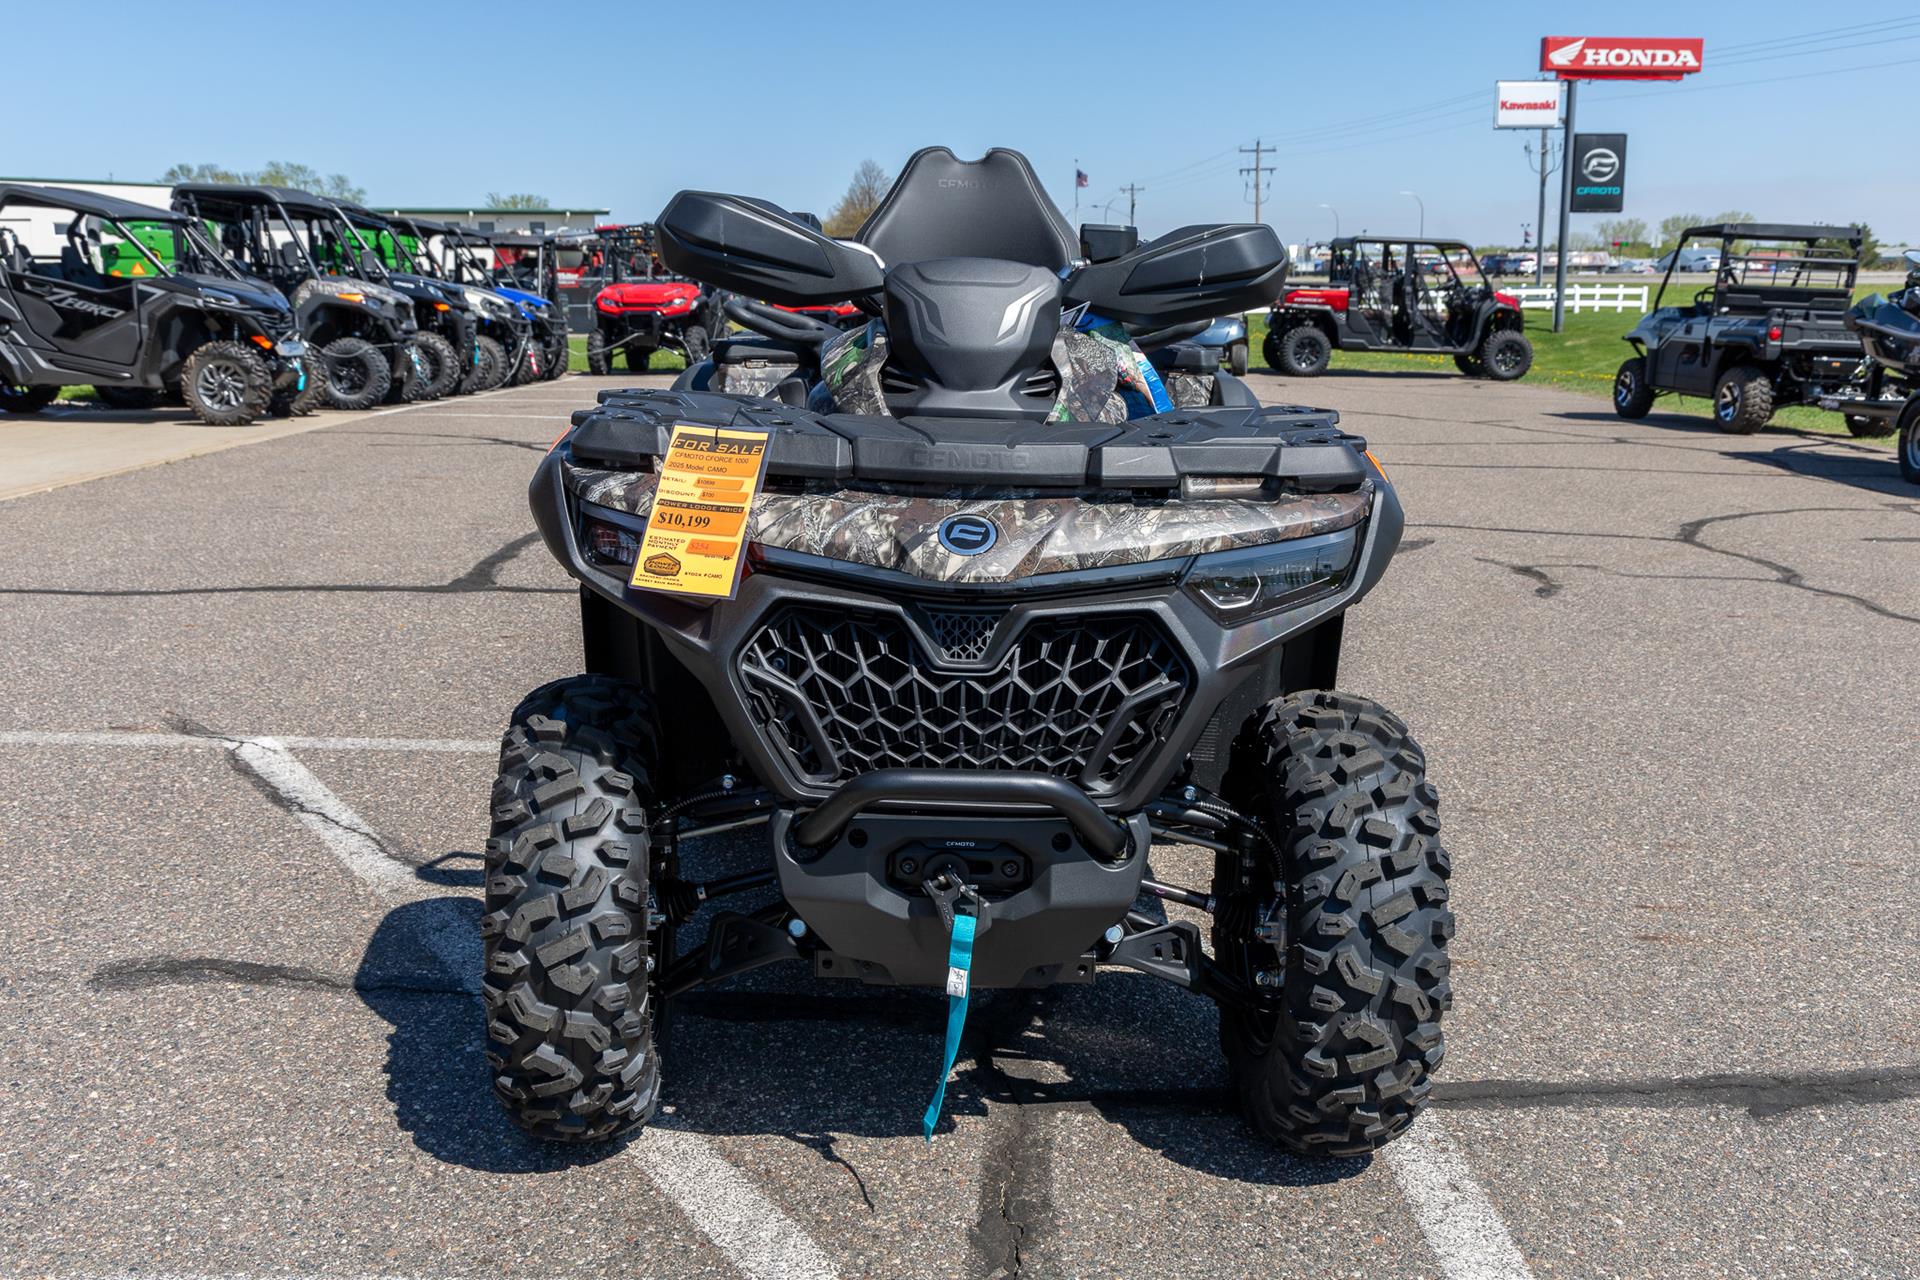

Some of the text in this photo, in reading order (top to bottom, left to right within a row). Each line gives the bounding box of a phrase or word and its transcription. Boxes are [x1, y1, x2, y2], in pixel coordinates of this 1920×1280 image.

[1583, 48, 1700, 67] HONDA
[1500, 100, 1557, 111] Kawasaki
[938, 178, 1002, 190] CFMO
[1576, 186, 1621, 195] CFMOTO
[673, 438, 764, 455] FOR SALE
[675, 451, 705, 461] CFMOTO
[705, 455, 733, 464] CFORCE
[668, 461, 685, 469] 2025
[685, 463, 704, 471] Model
[658, 488, 696, 497] DISCOUNT:
[659, 500, 688, 508] POWER
[657, 511, 711, 528] $10,199
[648, 539, 679, 547] MONTHLY
[649, 535, 686, 543] ESTIMATED
[647, 543, 678, 551] PAYMENT
